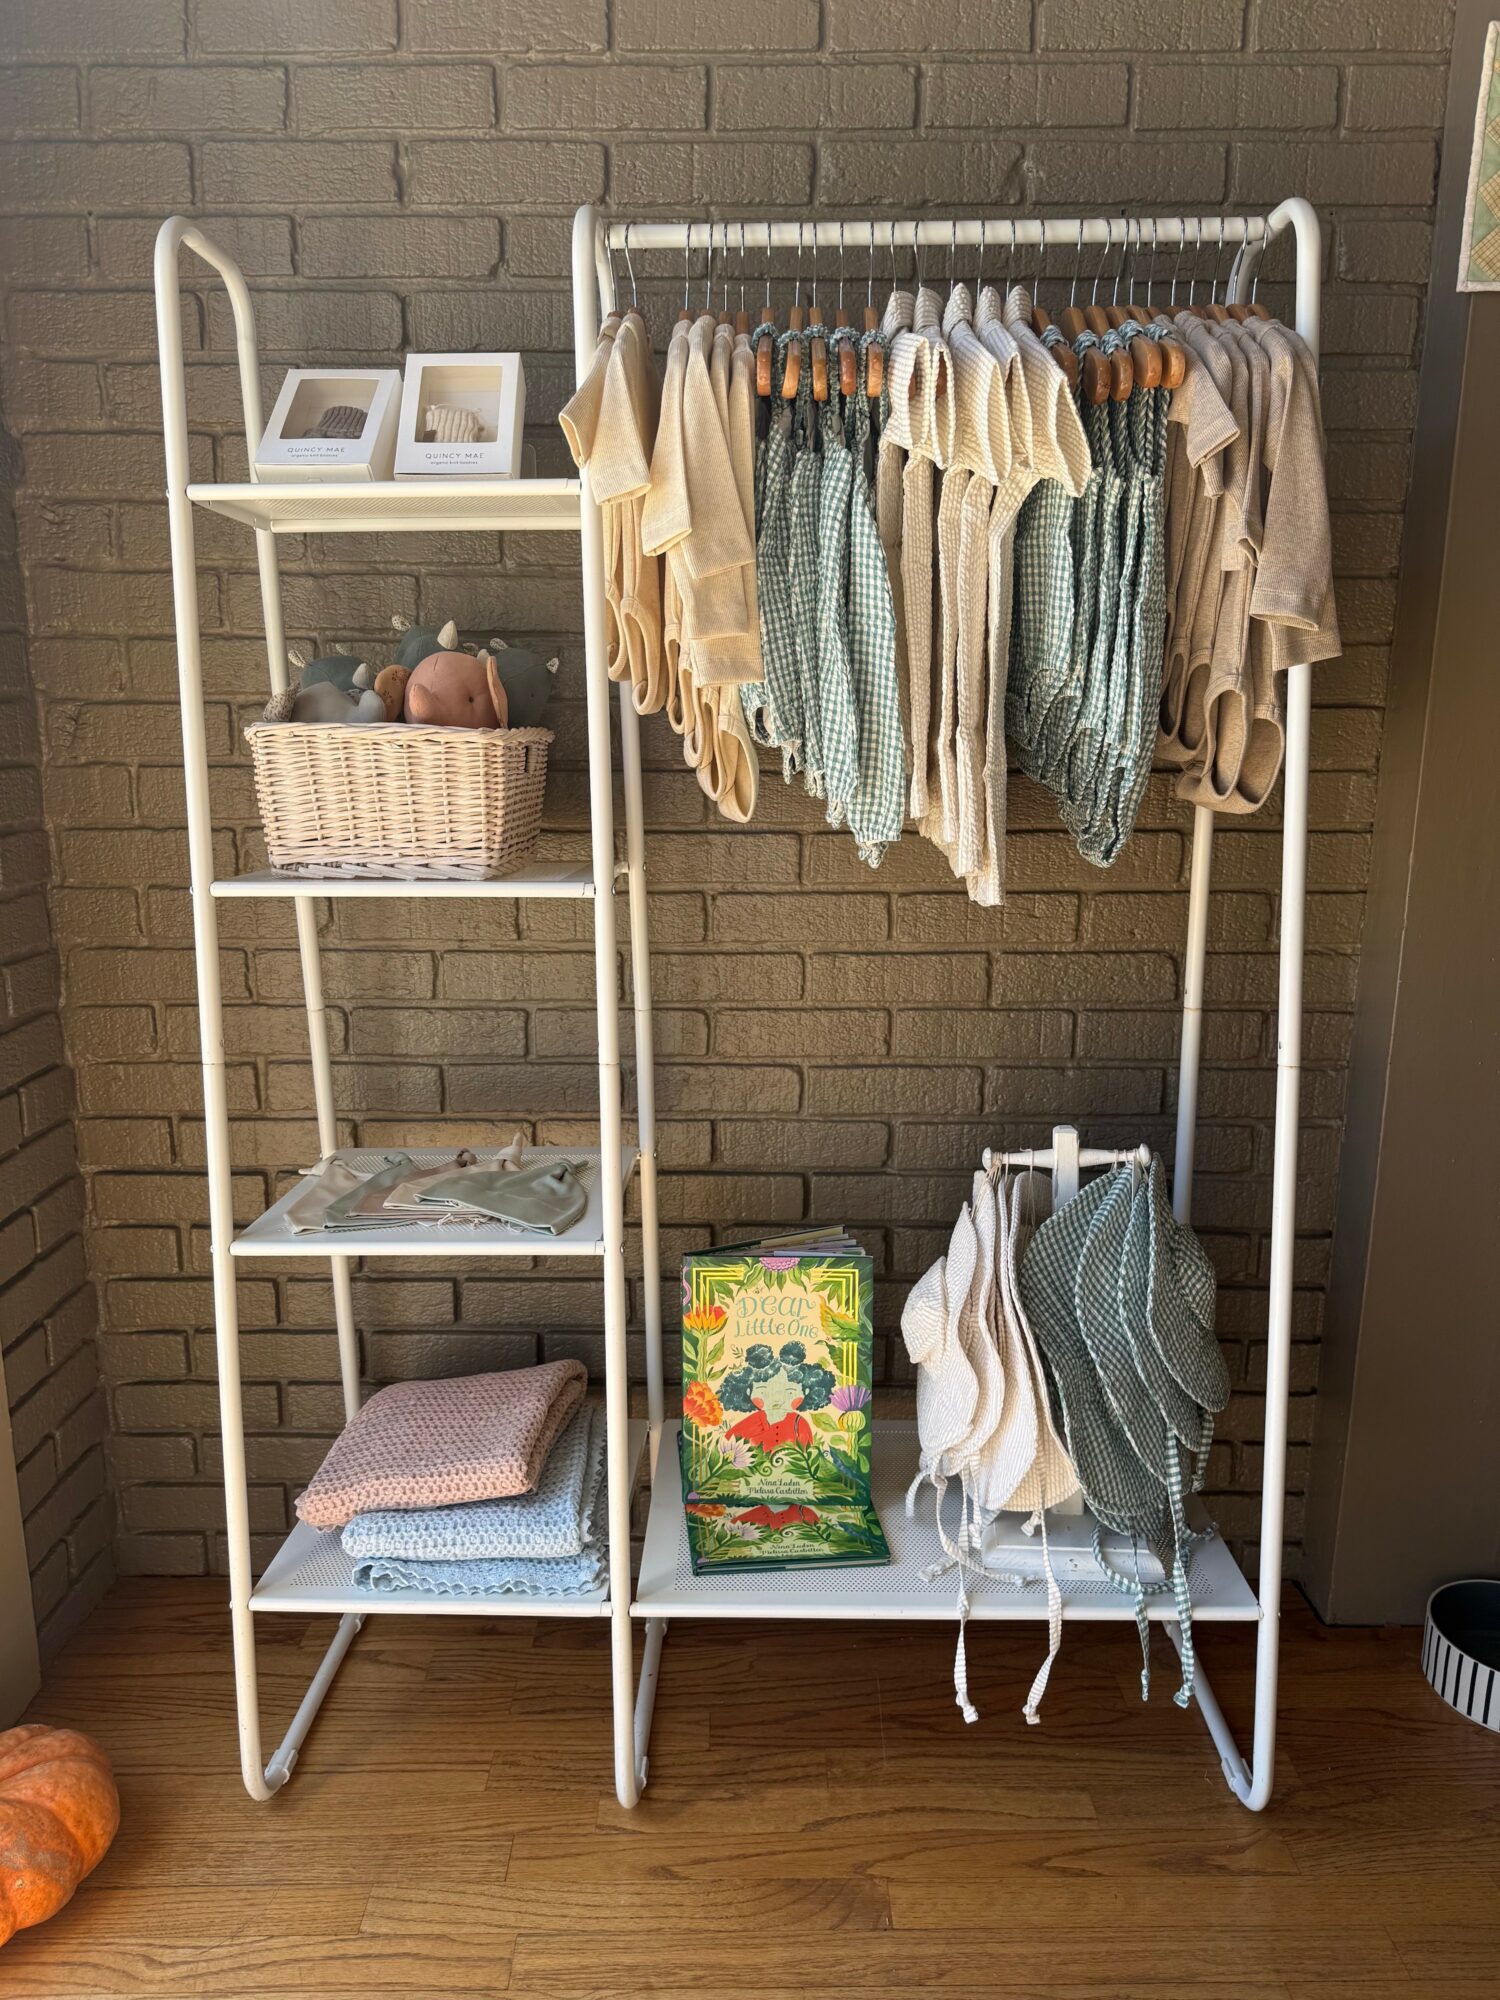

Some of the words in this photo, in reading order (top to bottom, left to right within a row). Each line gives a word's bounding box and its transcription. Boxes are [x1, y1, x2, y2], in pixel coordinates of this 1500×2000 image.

[735, 1295, 817, 1318] Dear
[734, 1318, 786, 1337] Little
[787, 1319, 819, 1338] One
[758, 1478, 777, 1486] Nina
[777, 1478, 801, 1486] Laden
[747, 1487, 775, 1495] Melissa
